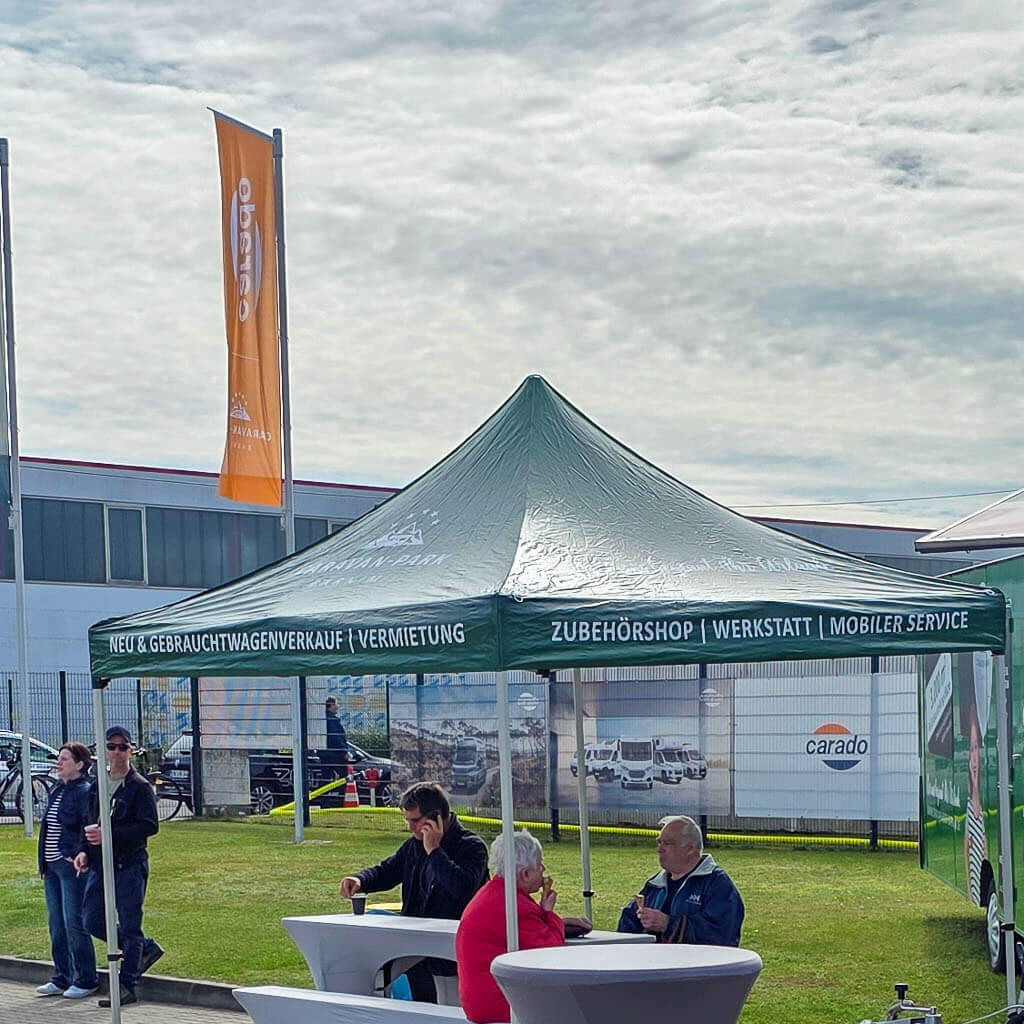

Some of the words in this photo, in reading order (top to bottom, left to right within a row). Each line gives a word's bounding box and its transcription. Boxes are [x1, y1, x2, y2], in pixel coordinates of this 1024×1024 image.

[109, 634, 135, 653] NEU
[137, 635, 148, 653] &
[149, 629, 343, 654] GEBRAUCHTWAGENVERKAUF
[359, 622, 466, 649] VERMIETUNG
[551, 616, 694, 642] ZUBEHÖRSHOP
[712, 616, 813, 638] WERKSTATT
[829, 614, 904, 635] MOBILER
[906, 611, 969, 633] SERVICE
[806, 734, 868, 755] carado
